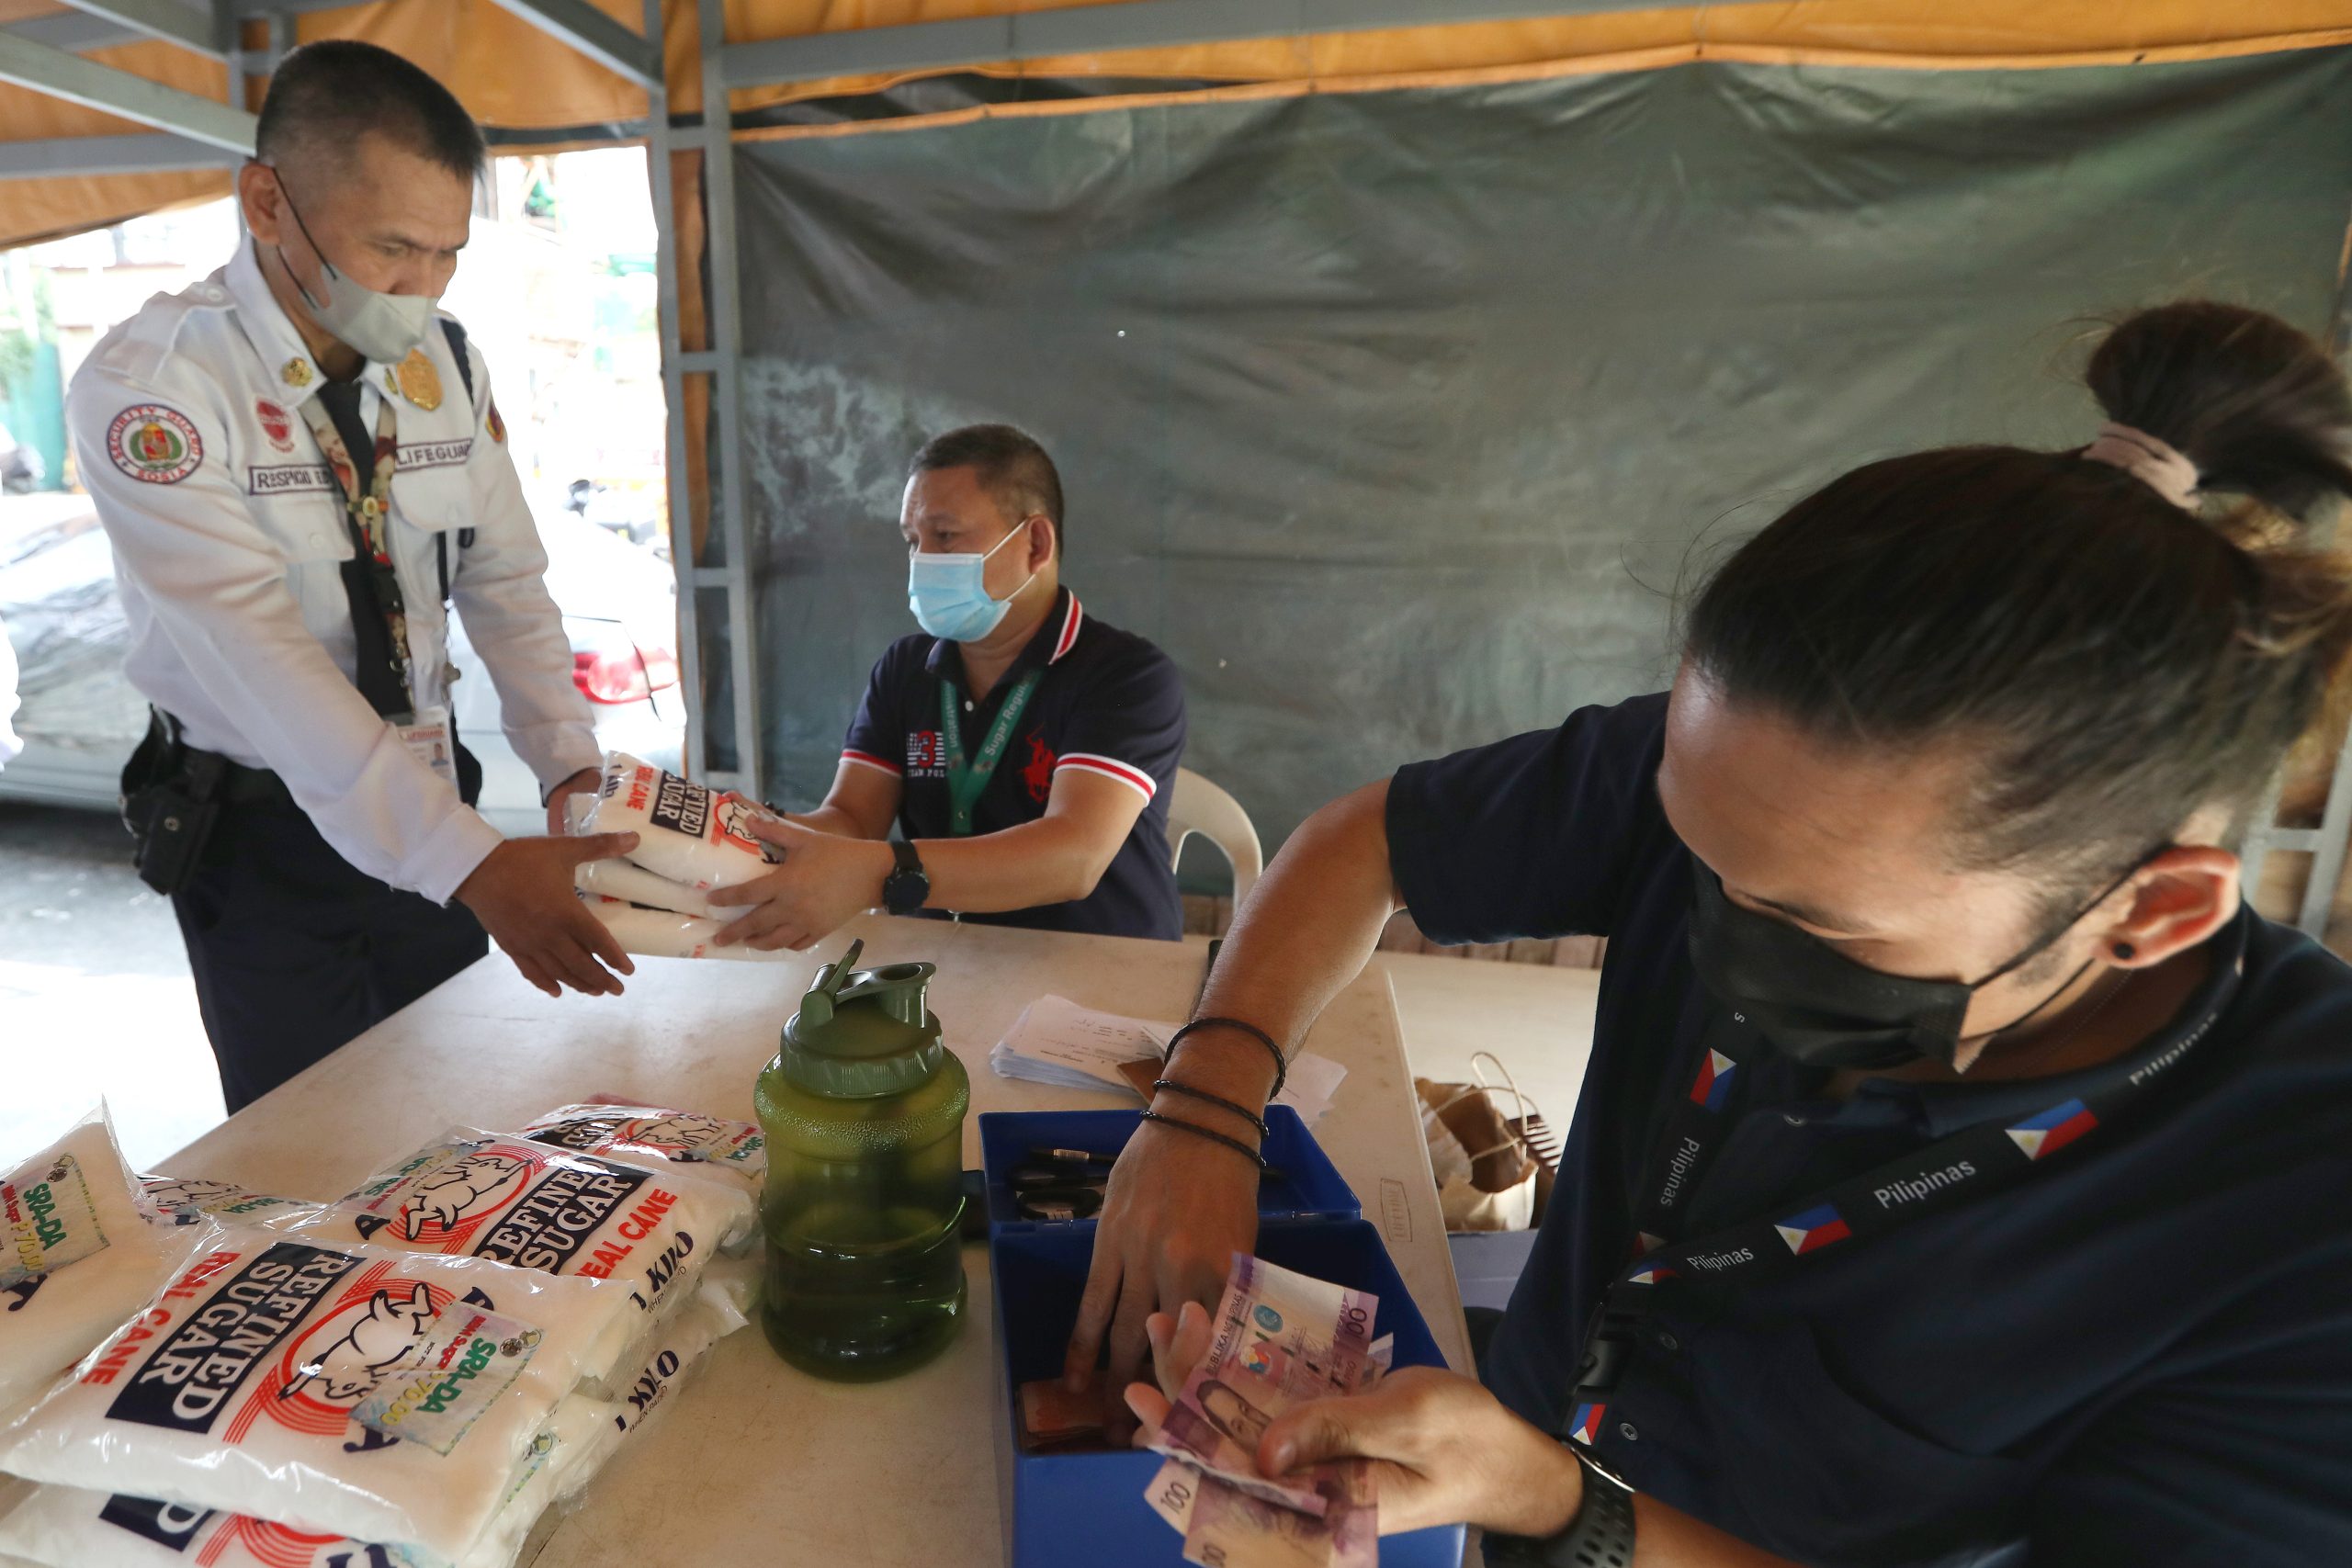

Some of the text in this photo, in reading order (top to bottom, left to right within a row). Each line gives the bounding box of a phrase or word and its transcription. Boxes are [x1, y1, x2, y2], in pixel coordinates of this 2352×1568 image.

[110, 406, 156, 459] SECURITY
[985, 722, 1009, 756] Sugar
[2129, 1011, 2217, 1087] Pilipinas
[1660, 1137, 1701, 1208] Pilipinas
[1873, 1158, 1977, 1210] Pilipinas
[521, 1175, 632, 1270] SUGAR
[575, 1188, 678, 1279] EAL CANE
[1686, 1245, 1755, 1272] Pilipinas
[80, 1251, 243, 1385] REAL CANE
[139, 1261, 288, 1385] SUGAR
[172, 1253, 358, 1420] REFINED
[1345, 1308, 1367, 1340] 100
[415, 1337, 497, 1414] SRA-DA
[1161, 1482, 1190, 1514] 100
